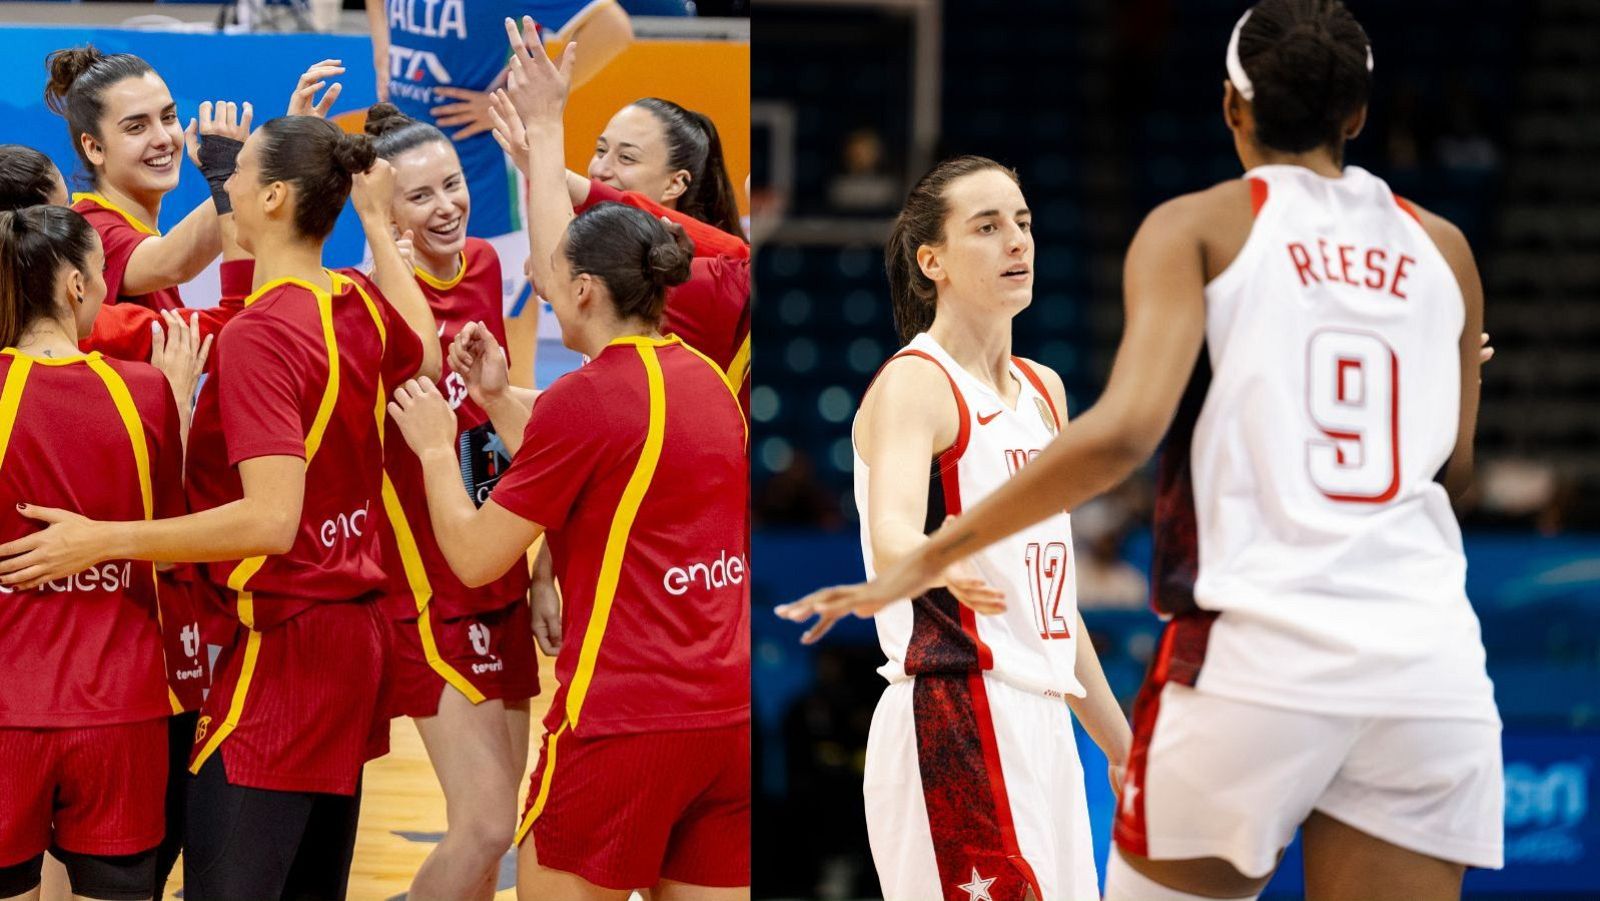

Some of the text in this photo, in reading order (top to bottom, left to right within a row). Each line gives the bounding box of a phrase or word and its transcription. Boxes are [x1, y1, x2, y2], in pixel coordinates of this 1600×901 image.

[385, 0, 467, 39] ALIA
[1287, 237, 1417, 300] REESE
[1305, 325, 1400, 504] 9
[663, 549, 746, 596] ende
[1025, 541, 1071, 640] 12
